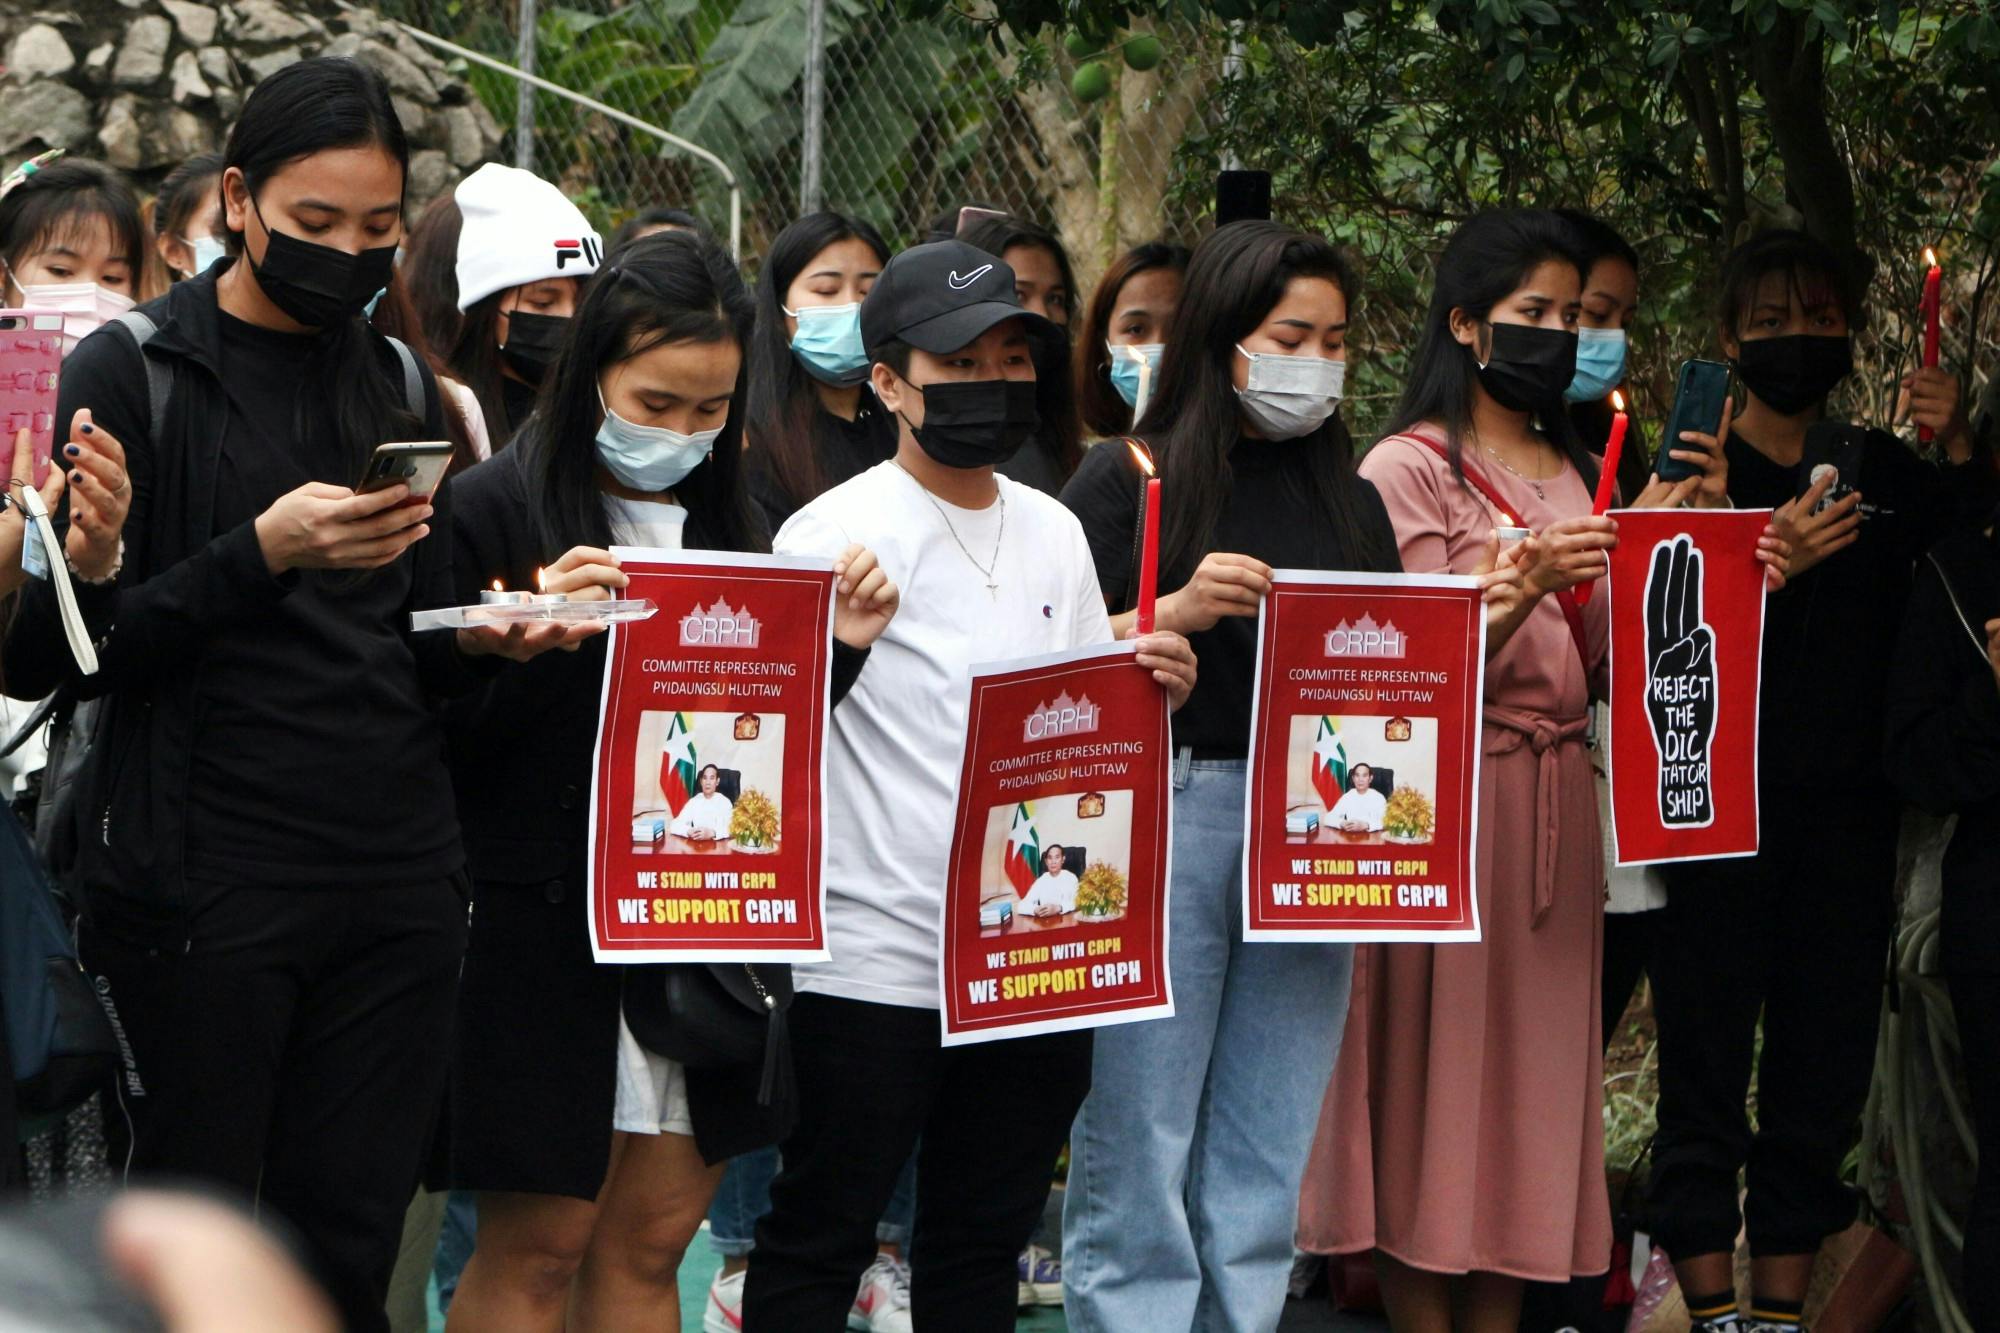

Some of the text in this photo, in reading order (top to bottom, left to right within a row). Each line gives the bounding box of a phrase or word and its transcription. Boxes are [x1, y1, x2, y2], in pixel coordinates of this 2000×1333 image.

[684, 616, 755, 645] CRPH
[1328, 630, 1400, 655] CRPH
[642, 659, 797, 676] COMMITTEE REPRESENTING
[1288, 668, 1448, 684] COMMITTEE REPRESENTING
[653, 681, 782, 697] PYIDAUNGSU HLUTTAW
[1300, 687, 1434, 703] PYIDAUNGSU HLUTTAW
[1653, 674, 1711, 703] REJECT
[1027, 705, 1094, 738] CRPH
[1664, 703, 1696, 730] THE
[989, 741, 1143, 773] COMMITTEE REPRESENTING
[1664, 729, 1702, 762] DIC
[999, 762, 1128, 790] PYIDAUNGSU HLUTTAW
[1662, 762, 1707, 787] TATOR
[1666, 786, 1704, 818] SHIP
[637, 871, 776, 889] WE STAND WITH CRPH
[1291, 859, 1428, 876] WE STAND WITH CRPH
[1272, 883, 1448, 907] WE SUPPORT CRPH
[617, 898, 797, 924] WE SUPPORT CRPH
[986, 937, 1122, 969] WE STAND WITH CRPH
[968, 959, 1142, 1005] WE SUPPORT CRPH
